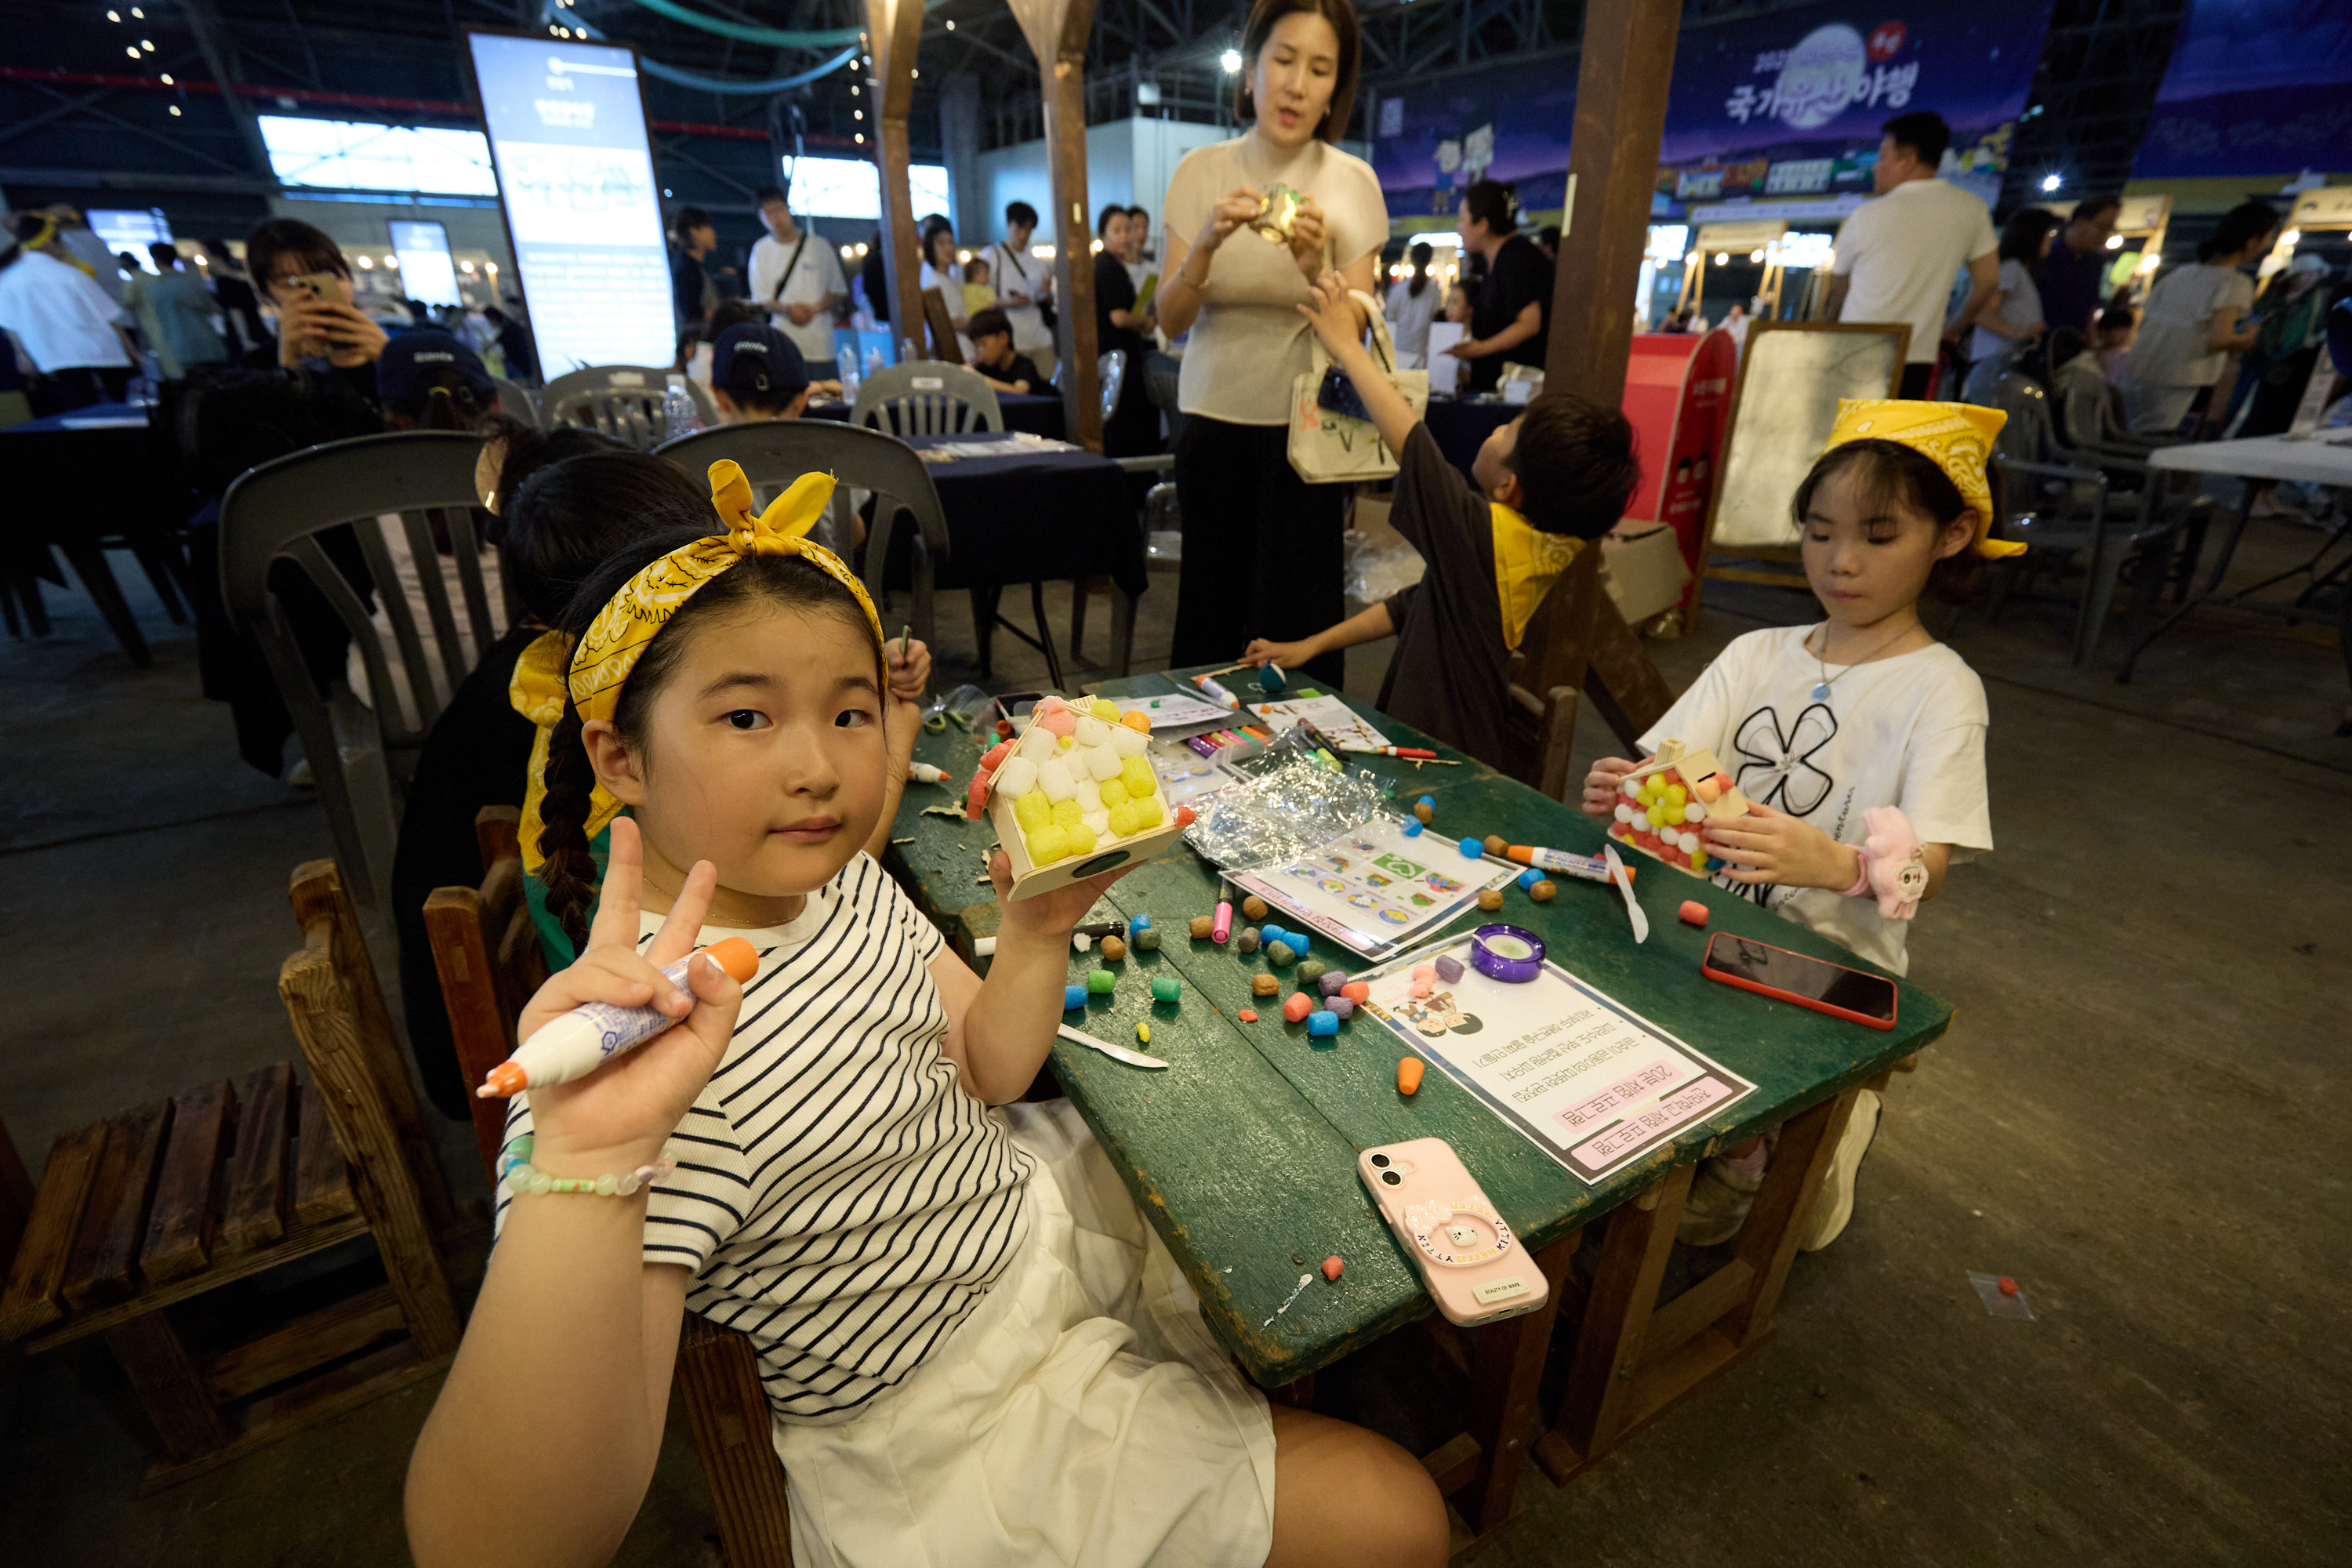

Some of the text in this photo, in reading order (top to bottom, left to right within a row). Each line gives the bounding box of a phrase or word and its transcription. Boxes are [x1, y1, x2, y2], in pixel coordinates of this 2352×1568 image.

[1472, 1008, 1595, 1069] 제1부두 해변구슬 팔찌 만들기
[1529, 1047, 1563, 1068] 컬러링
[1556, 1040, 1582, 1054] 부산
[1499, 1060, 1535, 1082] 파우치
[1511, 1036, 1640, 1103] 금순이 금동이의 따뜻한 판잣집
[1562, 1065, 1673, 1127] 20분 체험 프로그램
[1592, 1087, 1711, 1156] 천막학교 체험 프로그램
[1484, 1286, 1502, 1295] BEAUTY
